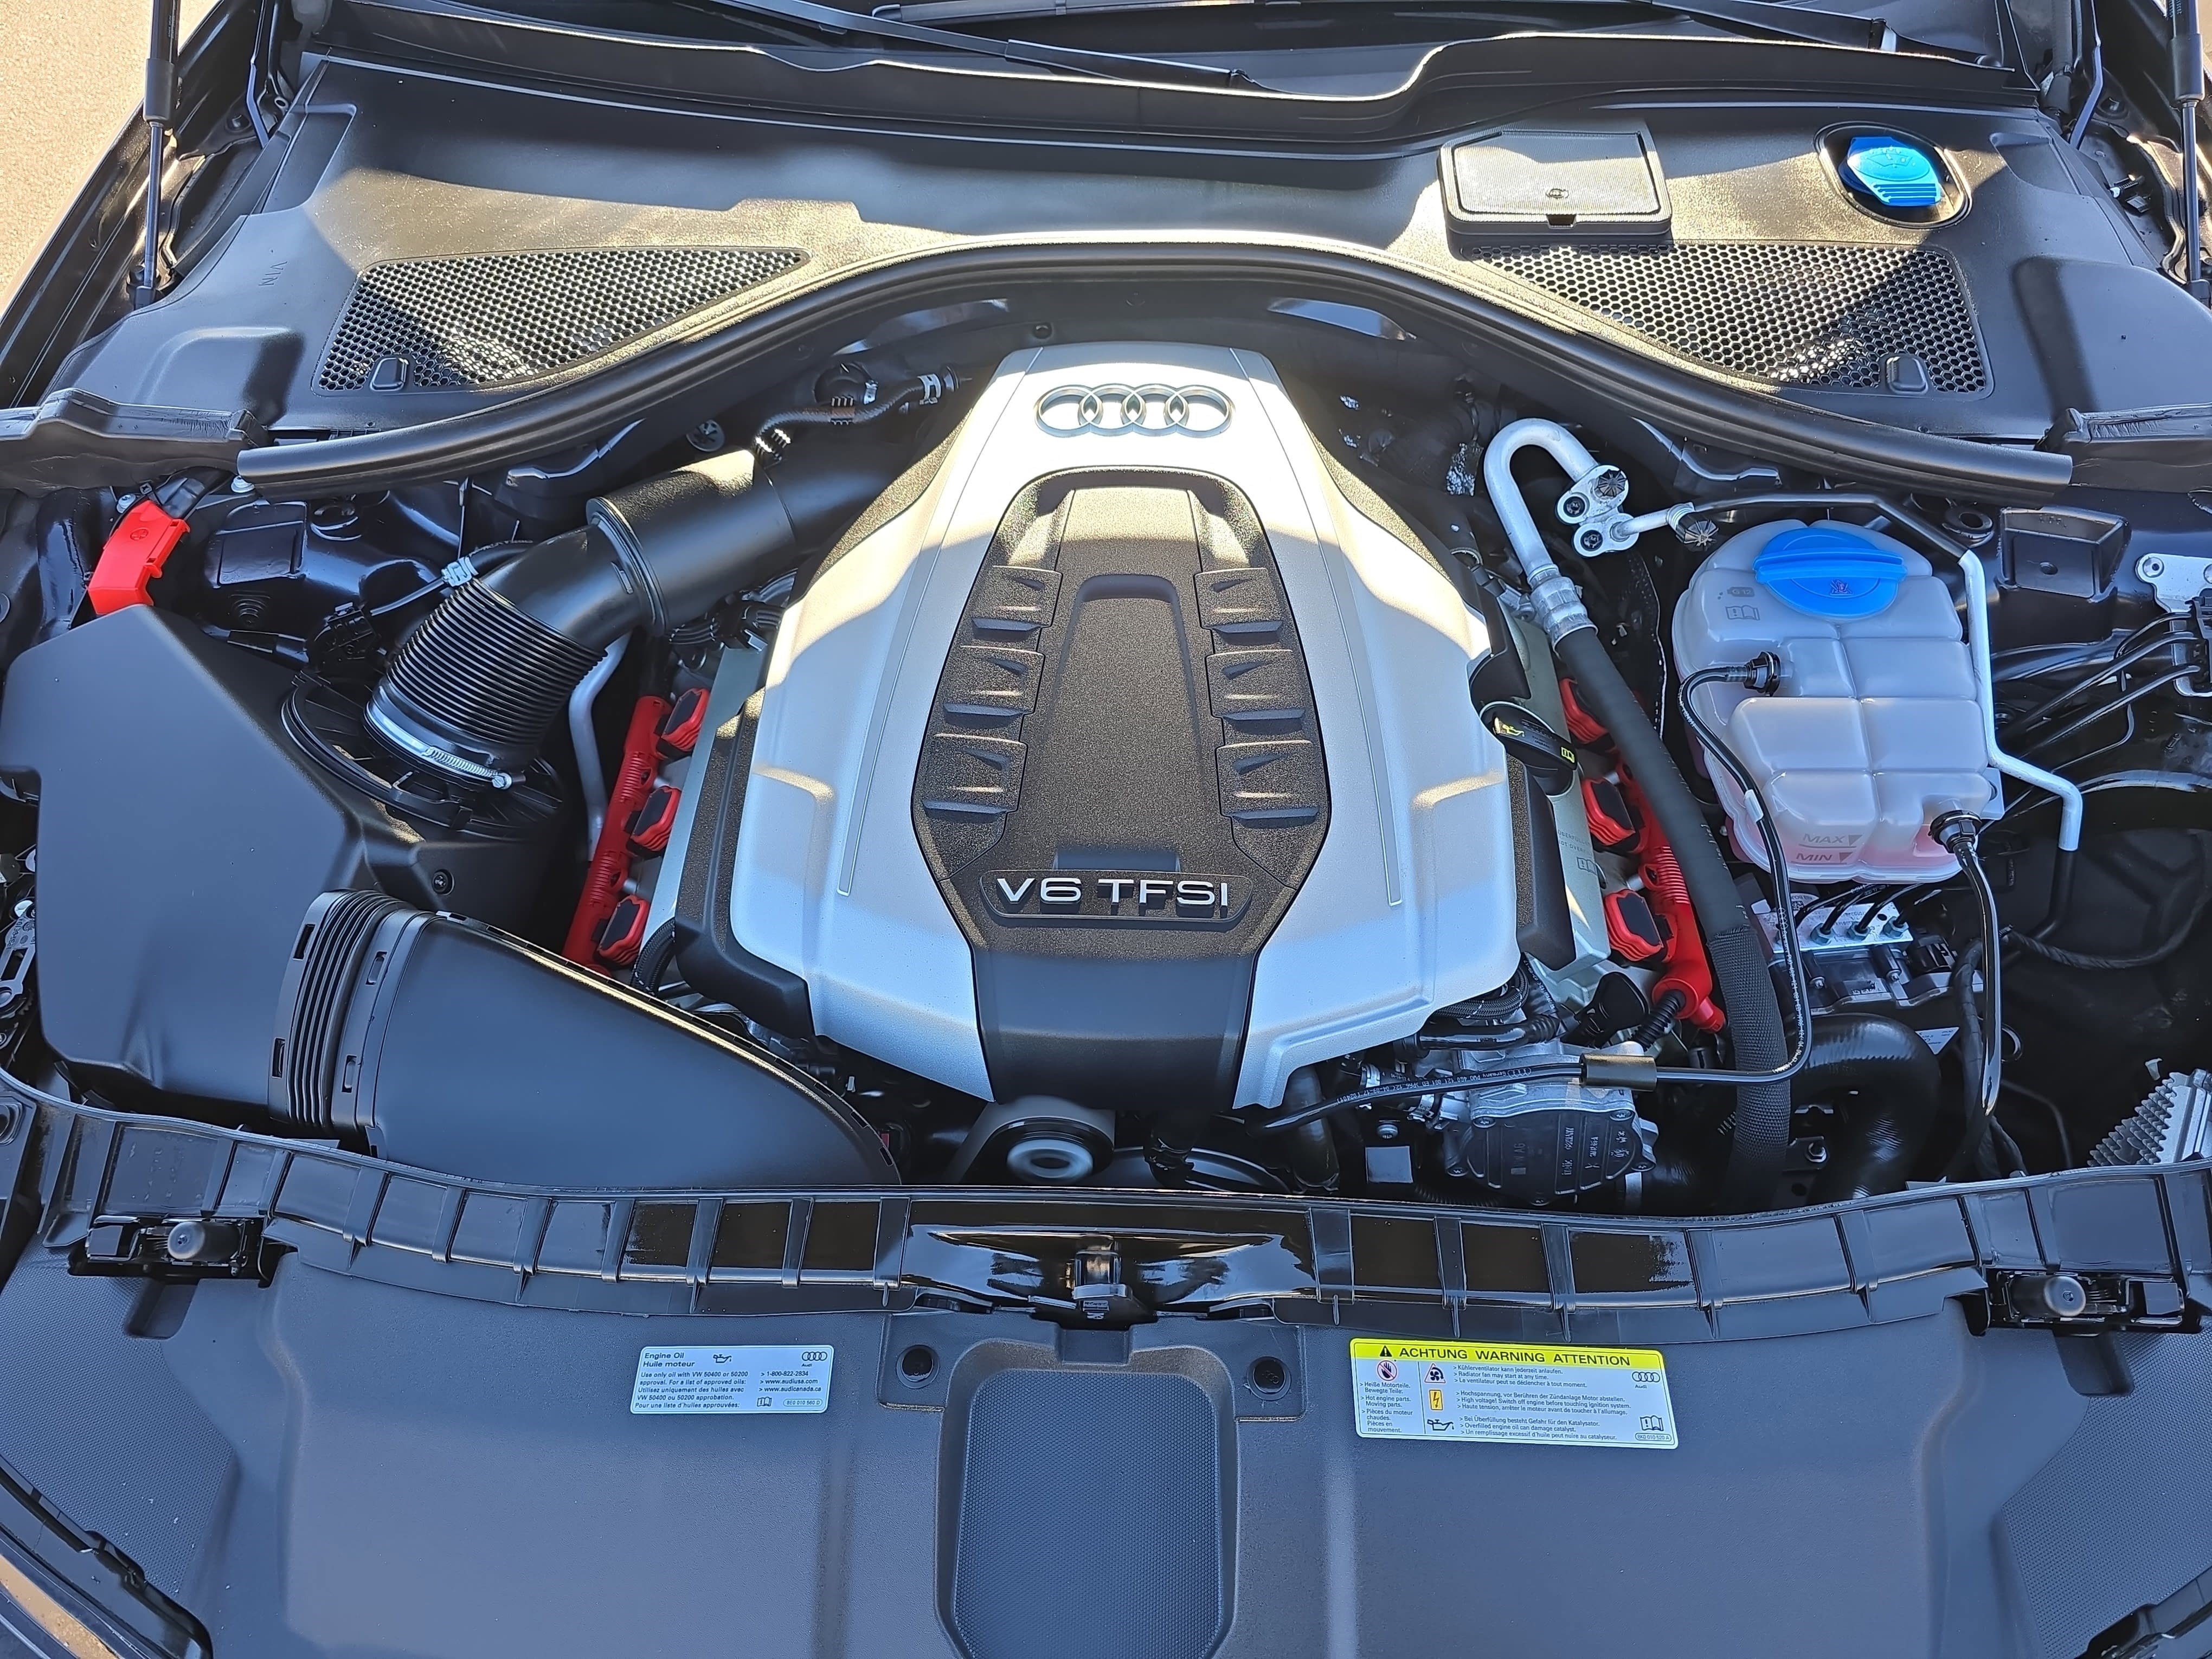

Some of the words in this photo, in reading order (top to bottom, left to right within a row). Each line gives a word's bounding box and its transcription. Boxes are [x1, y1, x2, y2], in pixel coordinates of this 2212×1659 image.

[1803, 833, 1845, 843] MAX
[1796, 853, 1832, 861] MIN
[997, 878, 1082, 904] V6
[1098, 879, 1227, 907] TFSI
[1399, 1348, 1467, 1360] ACHTUNG
[1476, 1351, 1545, 1362] WARNING
[1553, 1353, 1631, 1366] ATTENTION
[1475, 1415, 1506, 1423] Überfüllung
